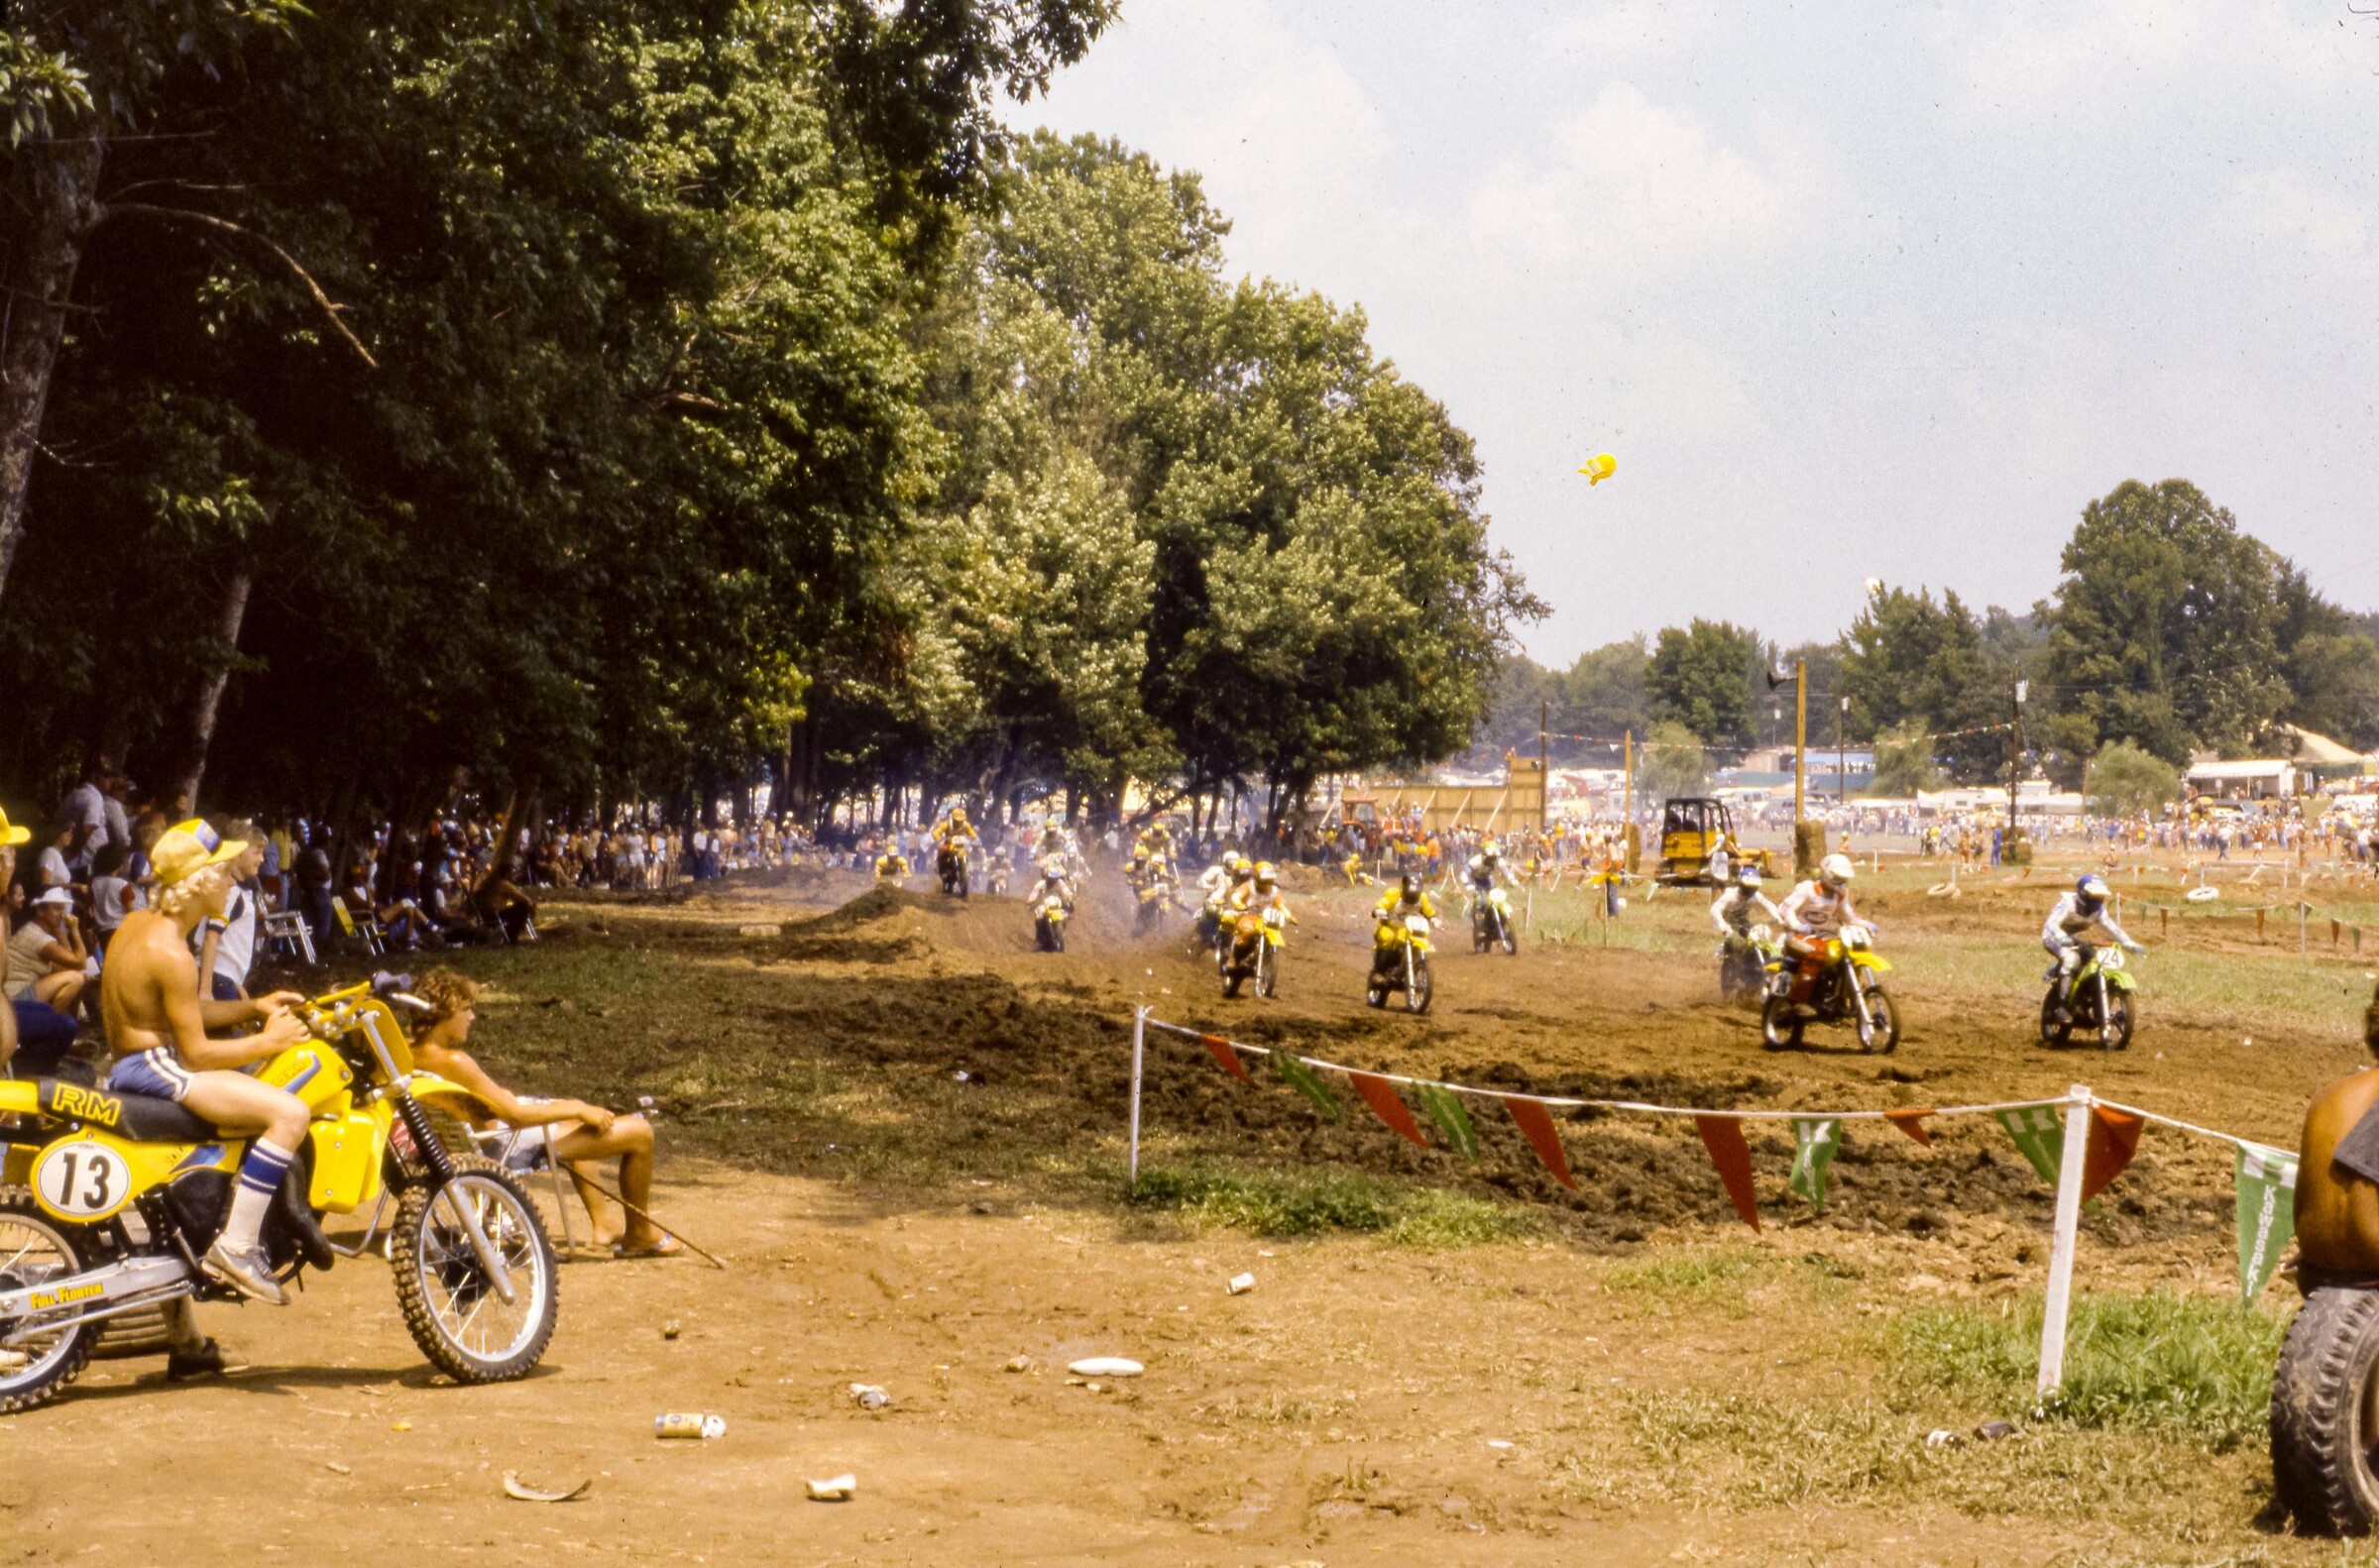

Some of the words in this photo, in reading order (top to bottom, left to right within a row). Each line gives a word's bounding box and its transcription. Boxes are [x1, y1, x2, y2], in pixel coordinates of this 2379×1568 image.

[2101, 949, 2119, 967] 24
[52, 1082, 121, 1126] RM
[59, 1152, 111, 1209] 13
